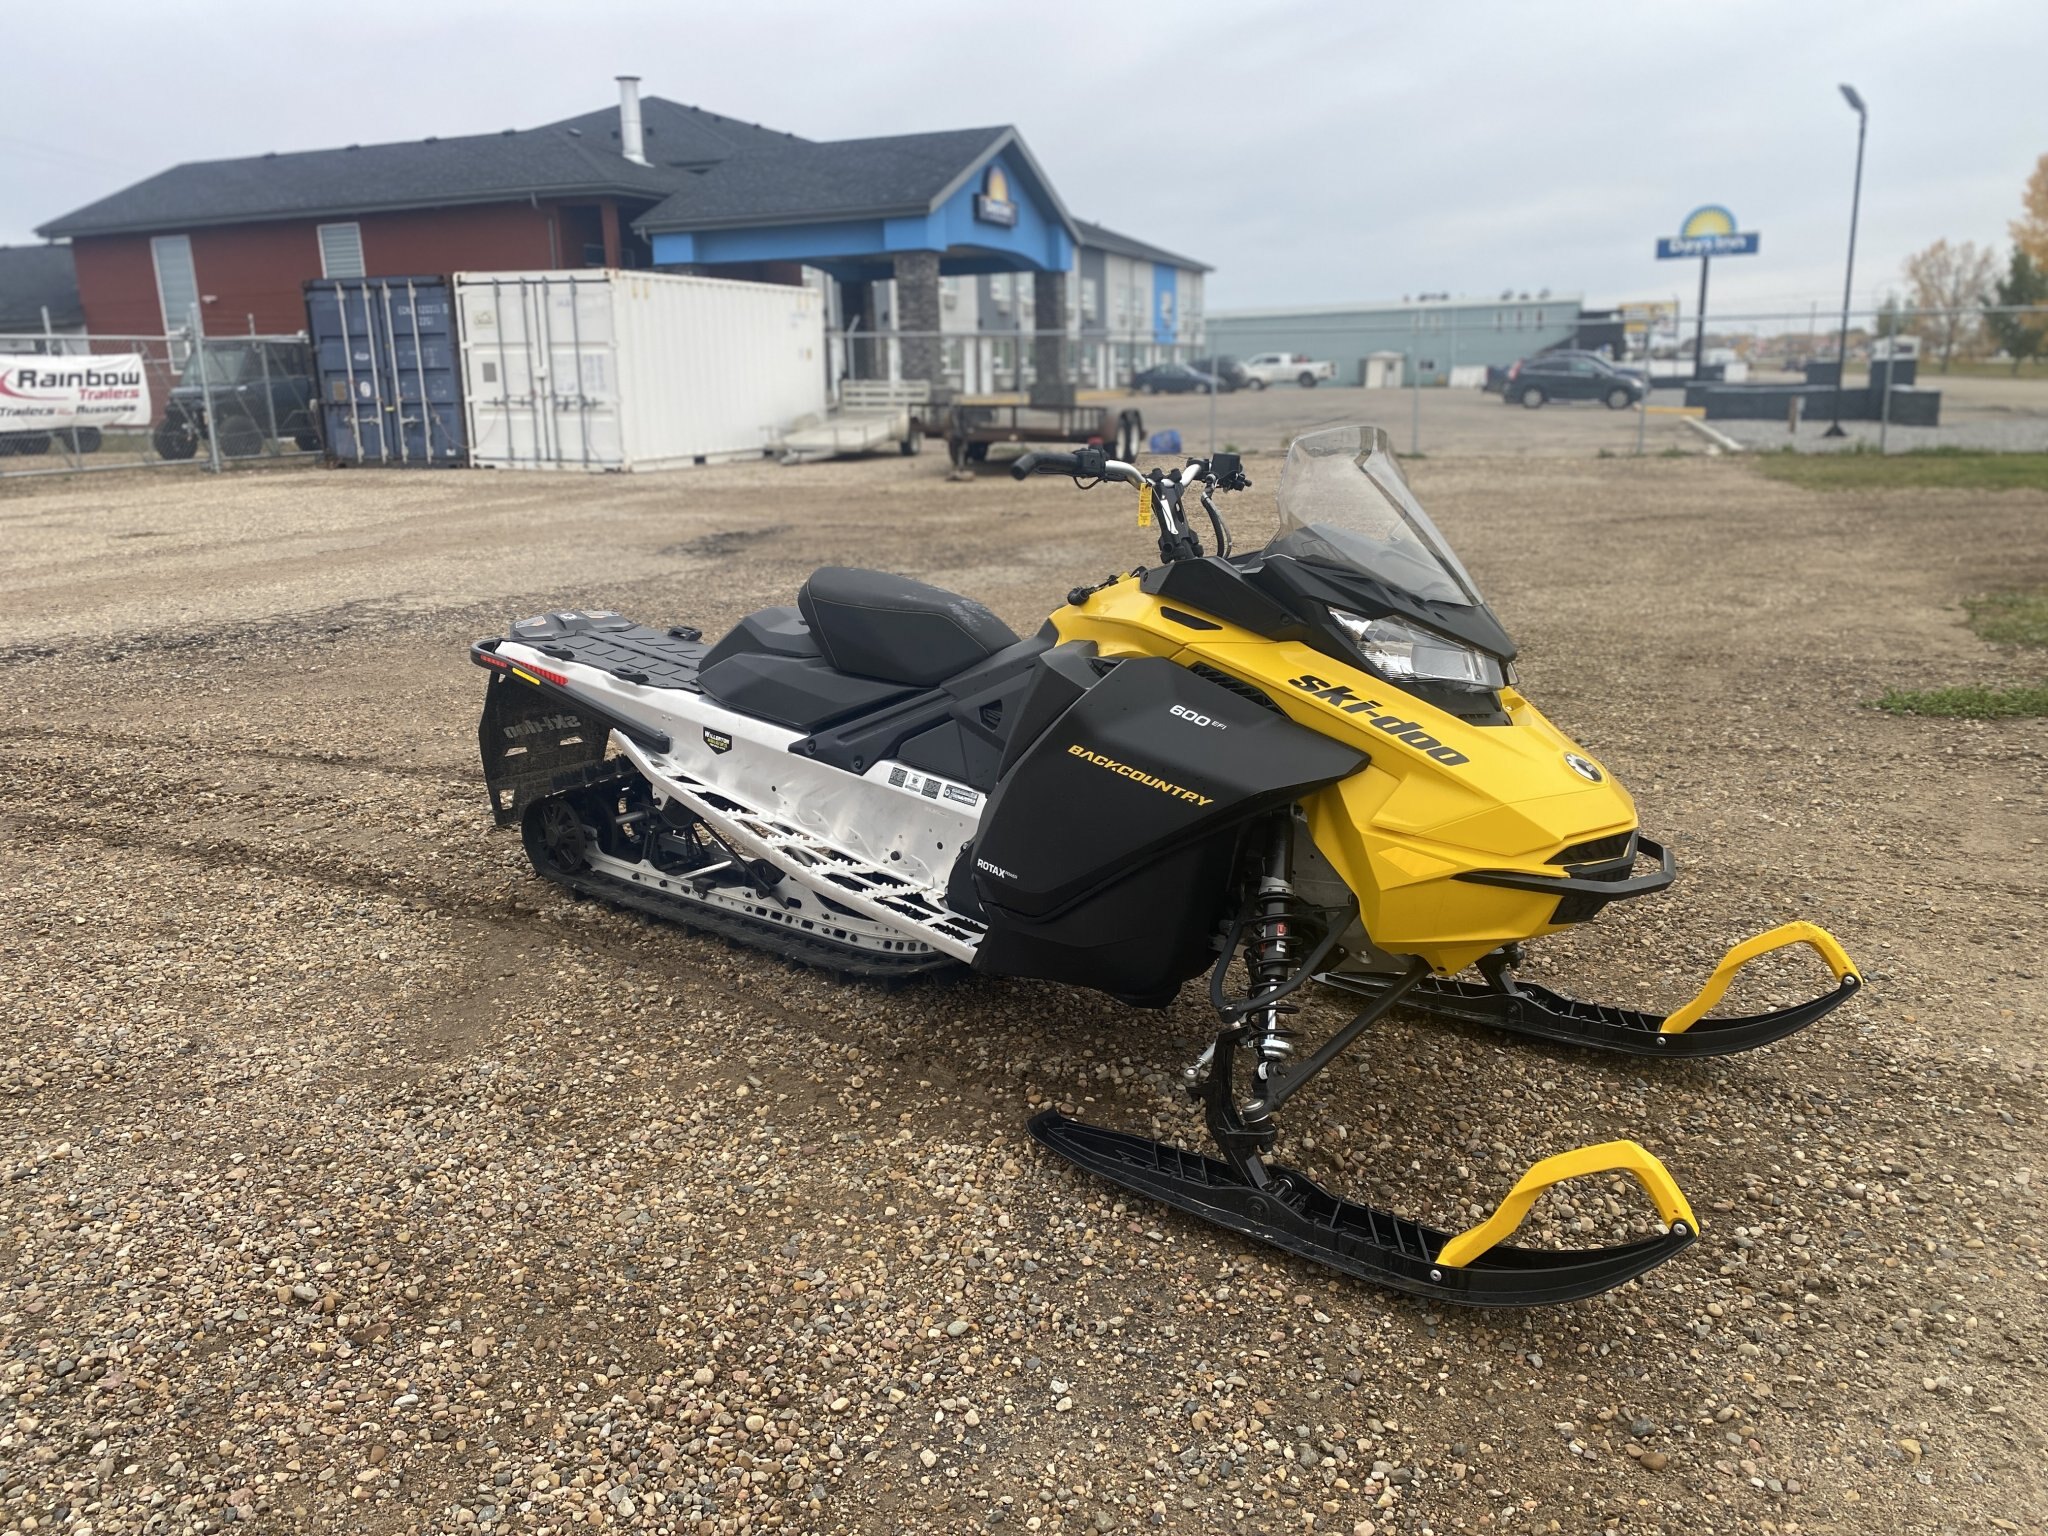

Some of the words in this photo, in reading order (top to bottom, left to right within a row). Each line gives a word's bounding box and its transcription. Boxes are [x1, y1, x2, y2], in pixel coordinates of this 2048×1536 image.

[1669, 238, 1712, 254] Days
[1715, 235, 1747, 250] Inn
[18, 369, 140, 388] Rainbow
[79, 388, 140, 400] Trailers
[0, 406, 55, 416] Trailers
[76, 404, 136, 414] Business
[1170, 704, 1211, 726] 600
[1211, 720, 1227, 730] EFI
[1288, 675, 1470, 766] ski-doo
[1067, 745, 1214, 806] BACKCOUNTRY
[977, 858, 1006, 879] ROTAX
